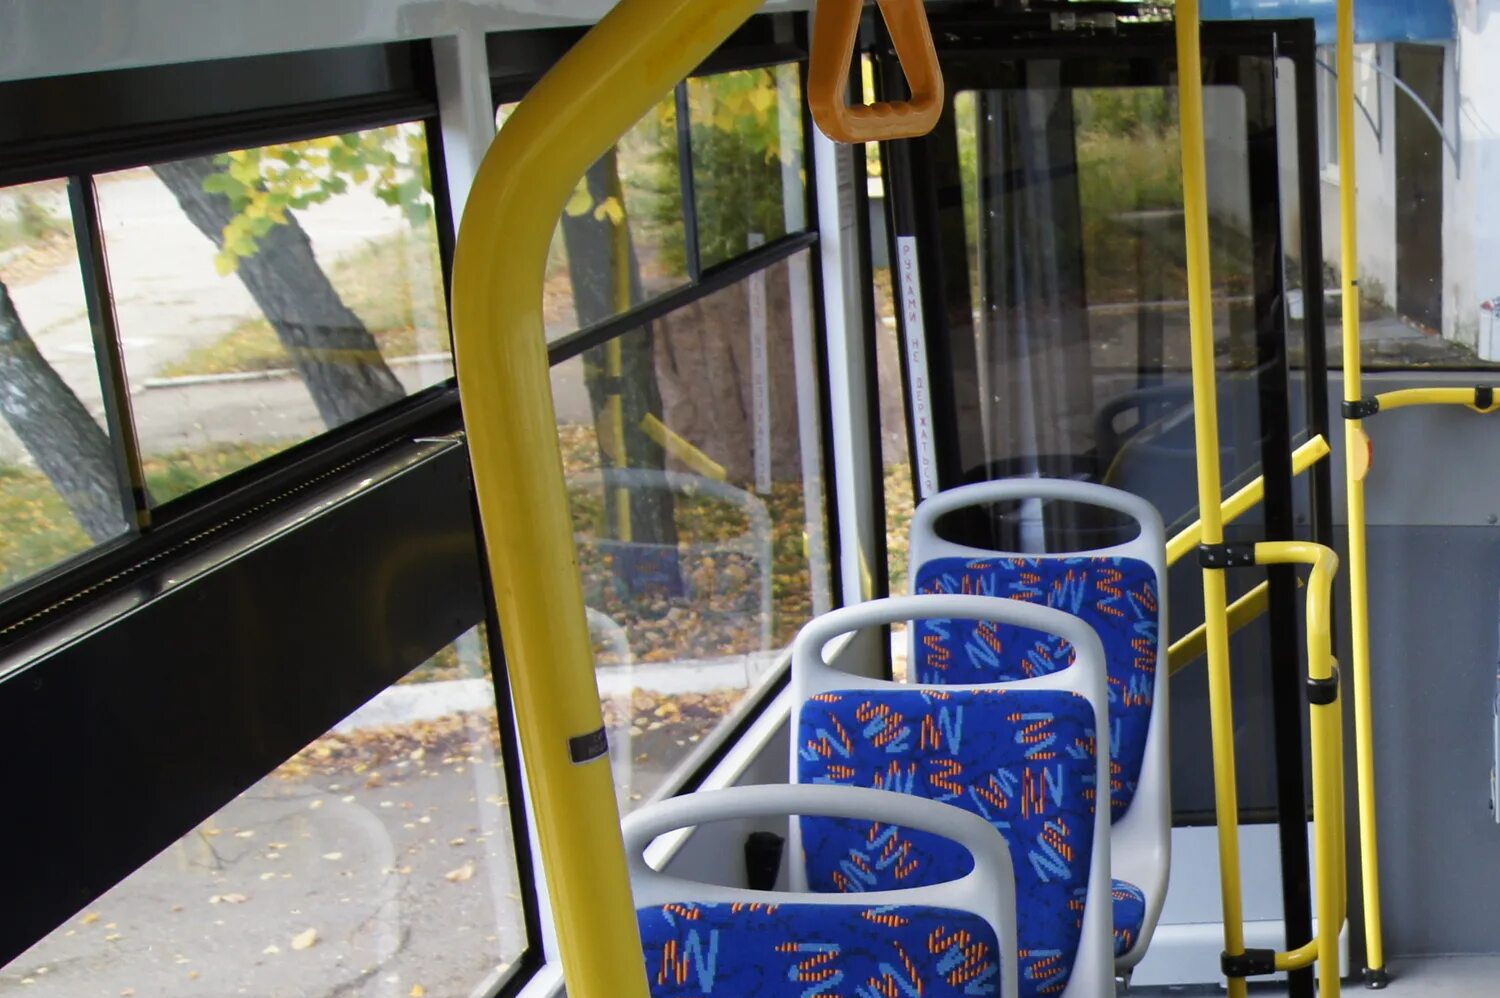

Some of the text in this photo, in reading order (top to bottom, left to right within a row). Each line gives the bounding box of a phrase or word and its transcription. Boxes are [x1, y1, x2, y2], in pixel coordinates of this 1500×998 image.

[902, 244, 932, 491] РУКАМИ НЕ ДЕРЖАТЬСЯ
